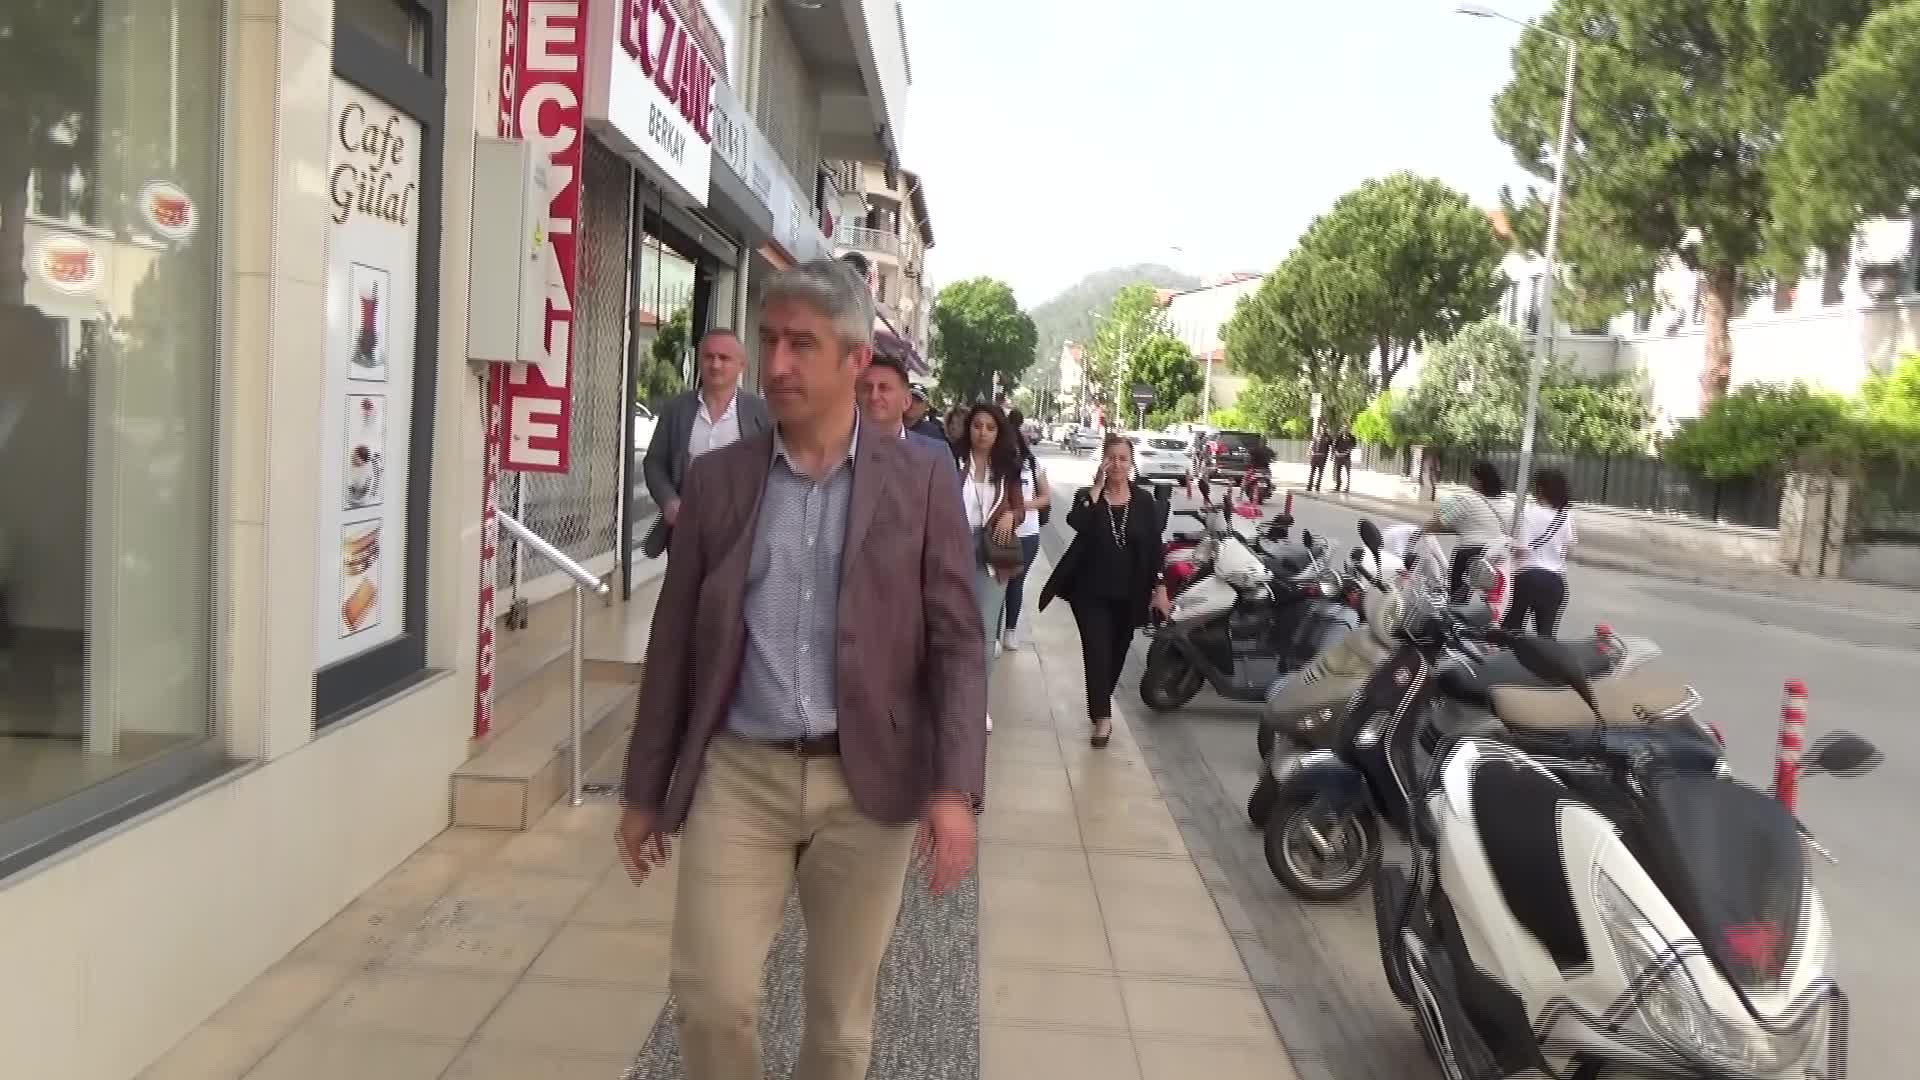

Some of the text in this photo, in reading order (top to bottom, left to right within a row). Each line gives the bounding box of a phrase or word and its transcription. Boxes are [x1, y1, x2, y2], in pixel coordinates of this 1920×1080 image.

[338, 102, 404, 172] Cafe
[649, 101, 686, 167] BERKAY
[330, 163, 415, 226] Gülal
[478, 403, 501, 721] PHARMACY
